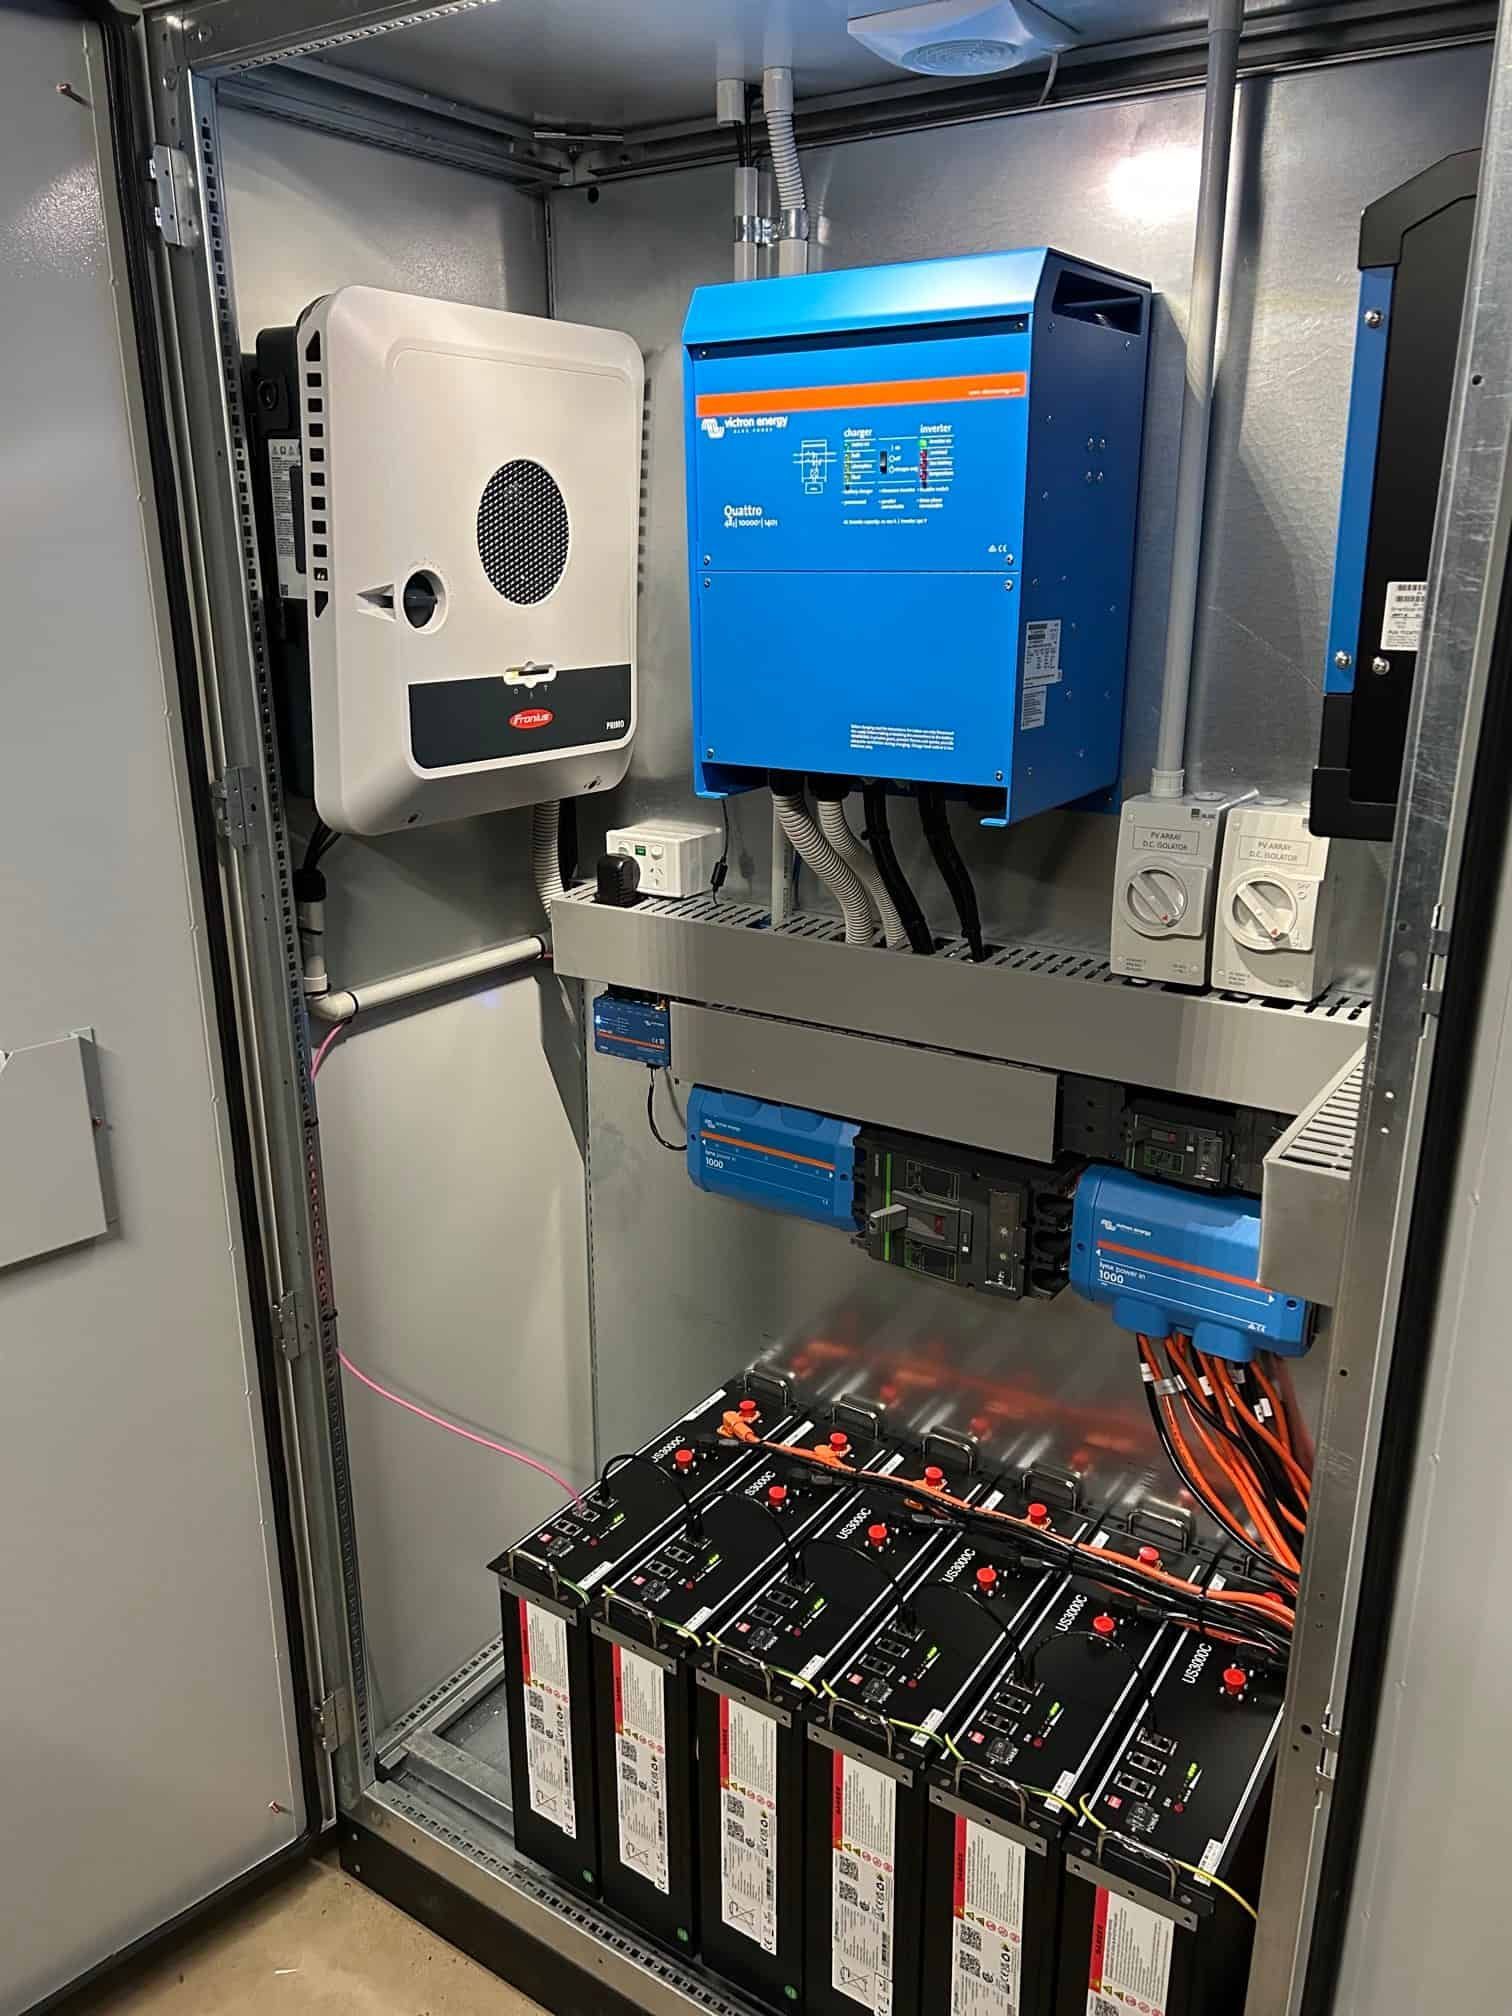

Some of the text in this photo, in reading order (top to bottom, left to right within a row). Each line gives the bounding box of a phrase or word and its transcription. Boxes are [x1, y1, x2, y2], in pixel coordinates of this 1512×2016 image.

[843, 428, 873, 439] charger
[920, 424, 952, 434] inverter
[724, 504, 763, 520] Quattro
[512, 712, 551, 726] Fronius
[705, 1156, 724, 1169] 1000
[1099, 1269, 1124, 1284] 1000
[836, 1507, 872, 1540] US3000C
[942, 1548, 976, 1583] US3000C
[1055, 1594, 1088, 1632] US3000C
[1181, 1643, 1213, 1685] US3000C
